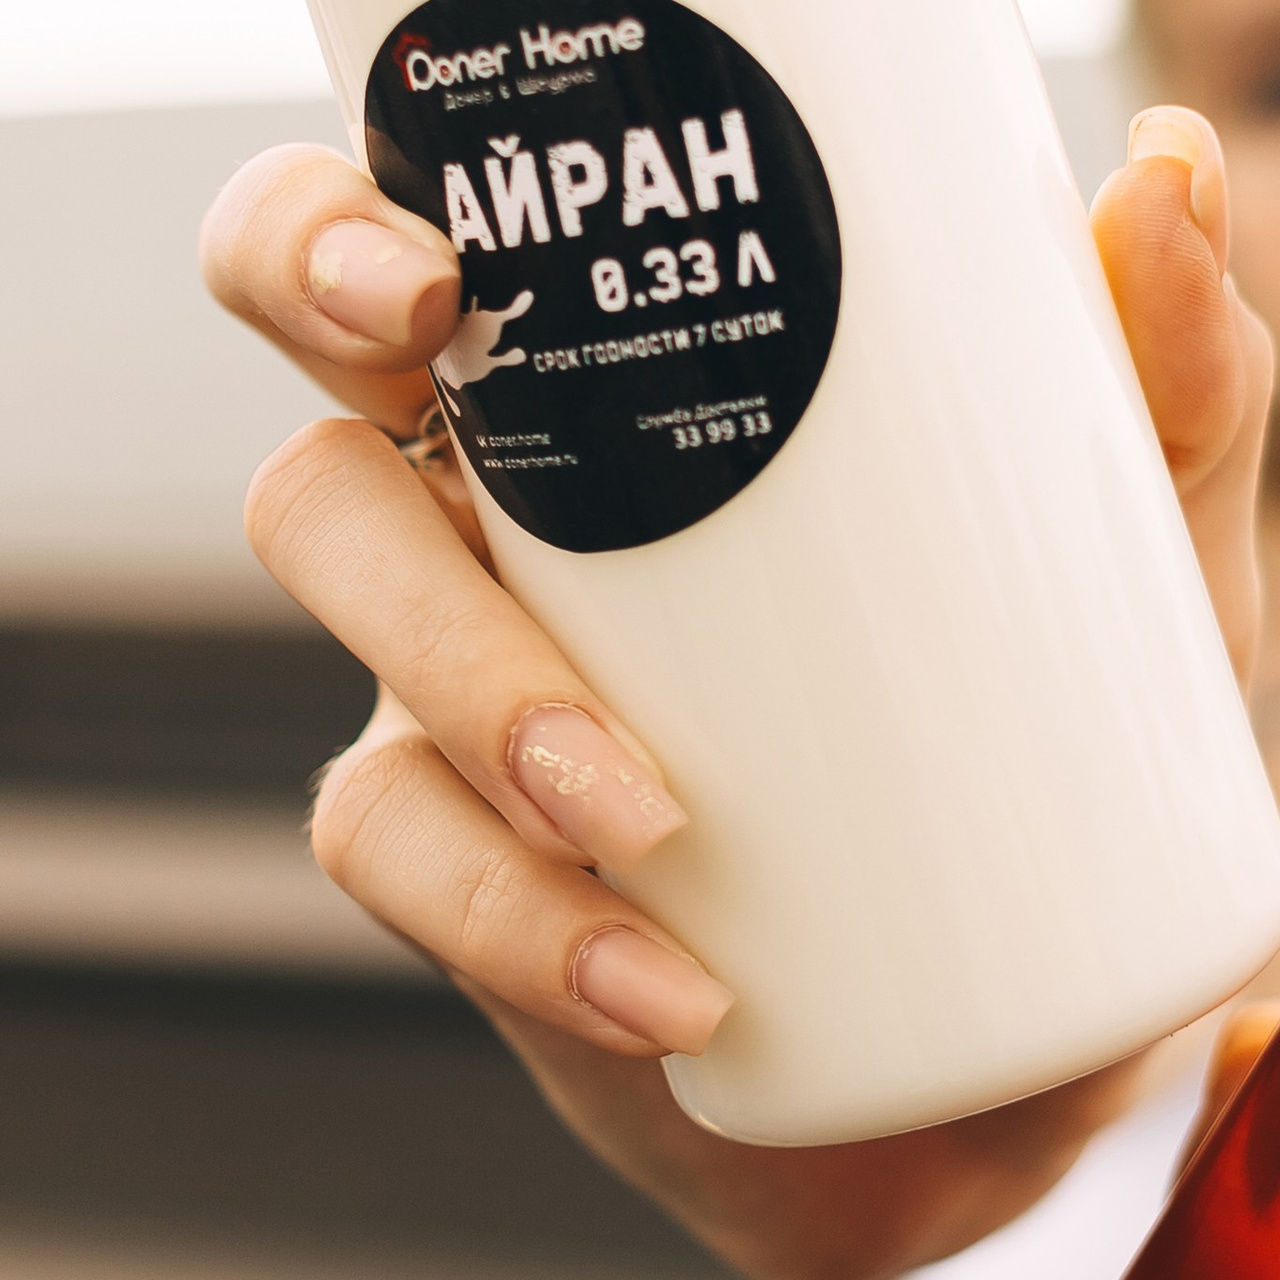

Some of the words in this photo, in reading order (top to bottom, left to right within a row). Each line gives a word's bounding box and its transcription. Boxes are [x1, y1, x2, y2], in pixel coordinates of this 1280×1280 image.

[404, 43, 511, 92] Doner
[519, 17, 646, 70] Home
[443, 108, 760, 254] АЙРАН
[591, 238, 722, 313] 0.33
[736, 229, 777, 288] Л
[533, 348, 581, 373] СРОК
[582, 327, 692, 366] ГОДНОСТИ
[692, 324, 707, 348] 7
[711, 309, 786, 344] СУТОК
[672, 424, 704, 451] 33
[705, 417, 737, 444] 99
[740, 410, 773, 435] 33
